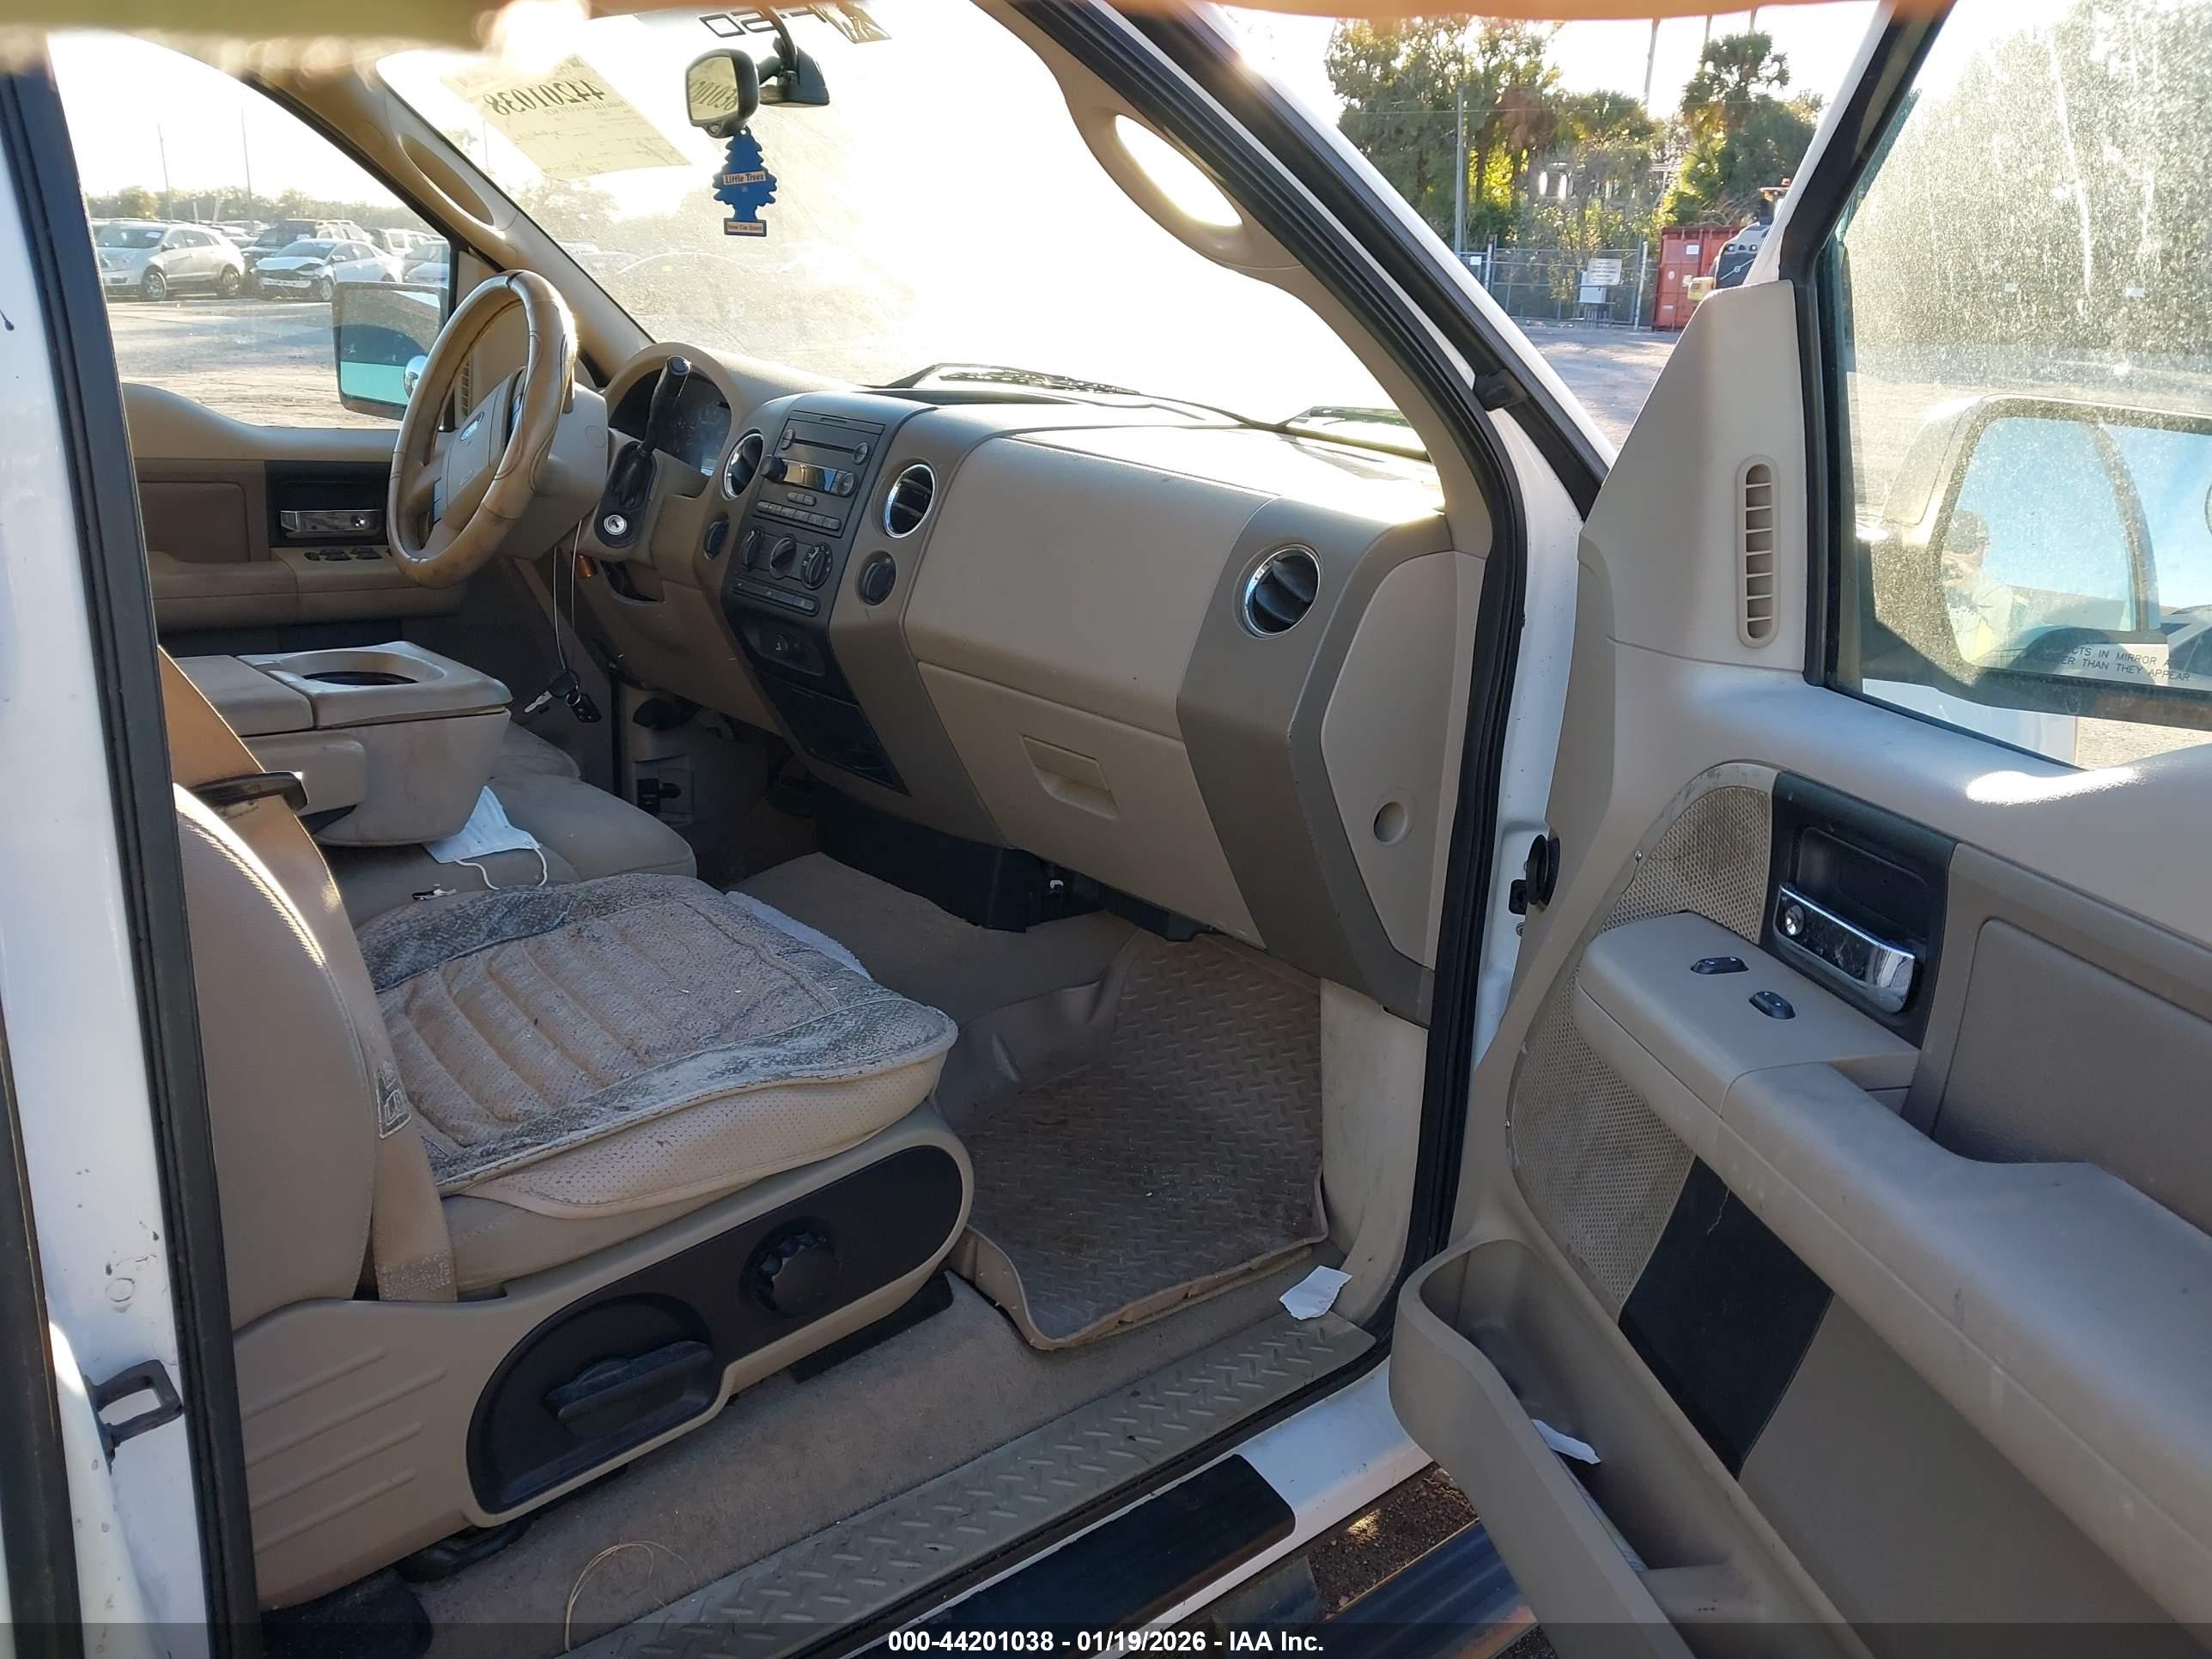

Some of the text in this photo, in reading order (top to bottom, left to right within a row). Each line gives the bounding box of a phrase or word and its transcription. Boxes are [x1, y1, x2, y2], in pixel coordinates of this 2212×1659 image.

[725, 172, 764, 184] Little Trees
[2098, 649, 2110, 659] IN
[2116, 652, 2157, 665] MIRROR
[2081, 658, 2110, 670] THAN
[2116, 663, 2143, 674] THEY
[2148, 668, 2191, 681] APPEAR
